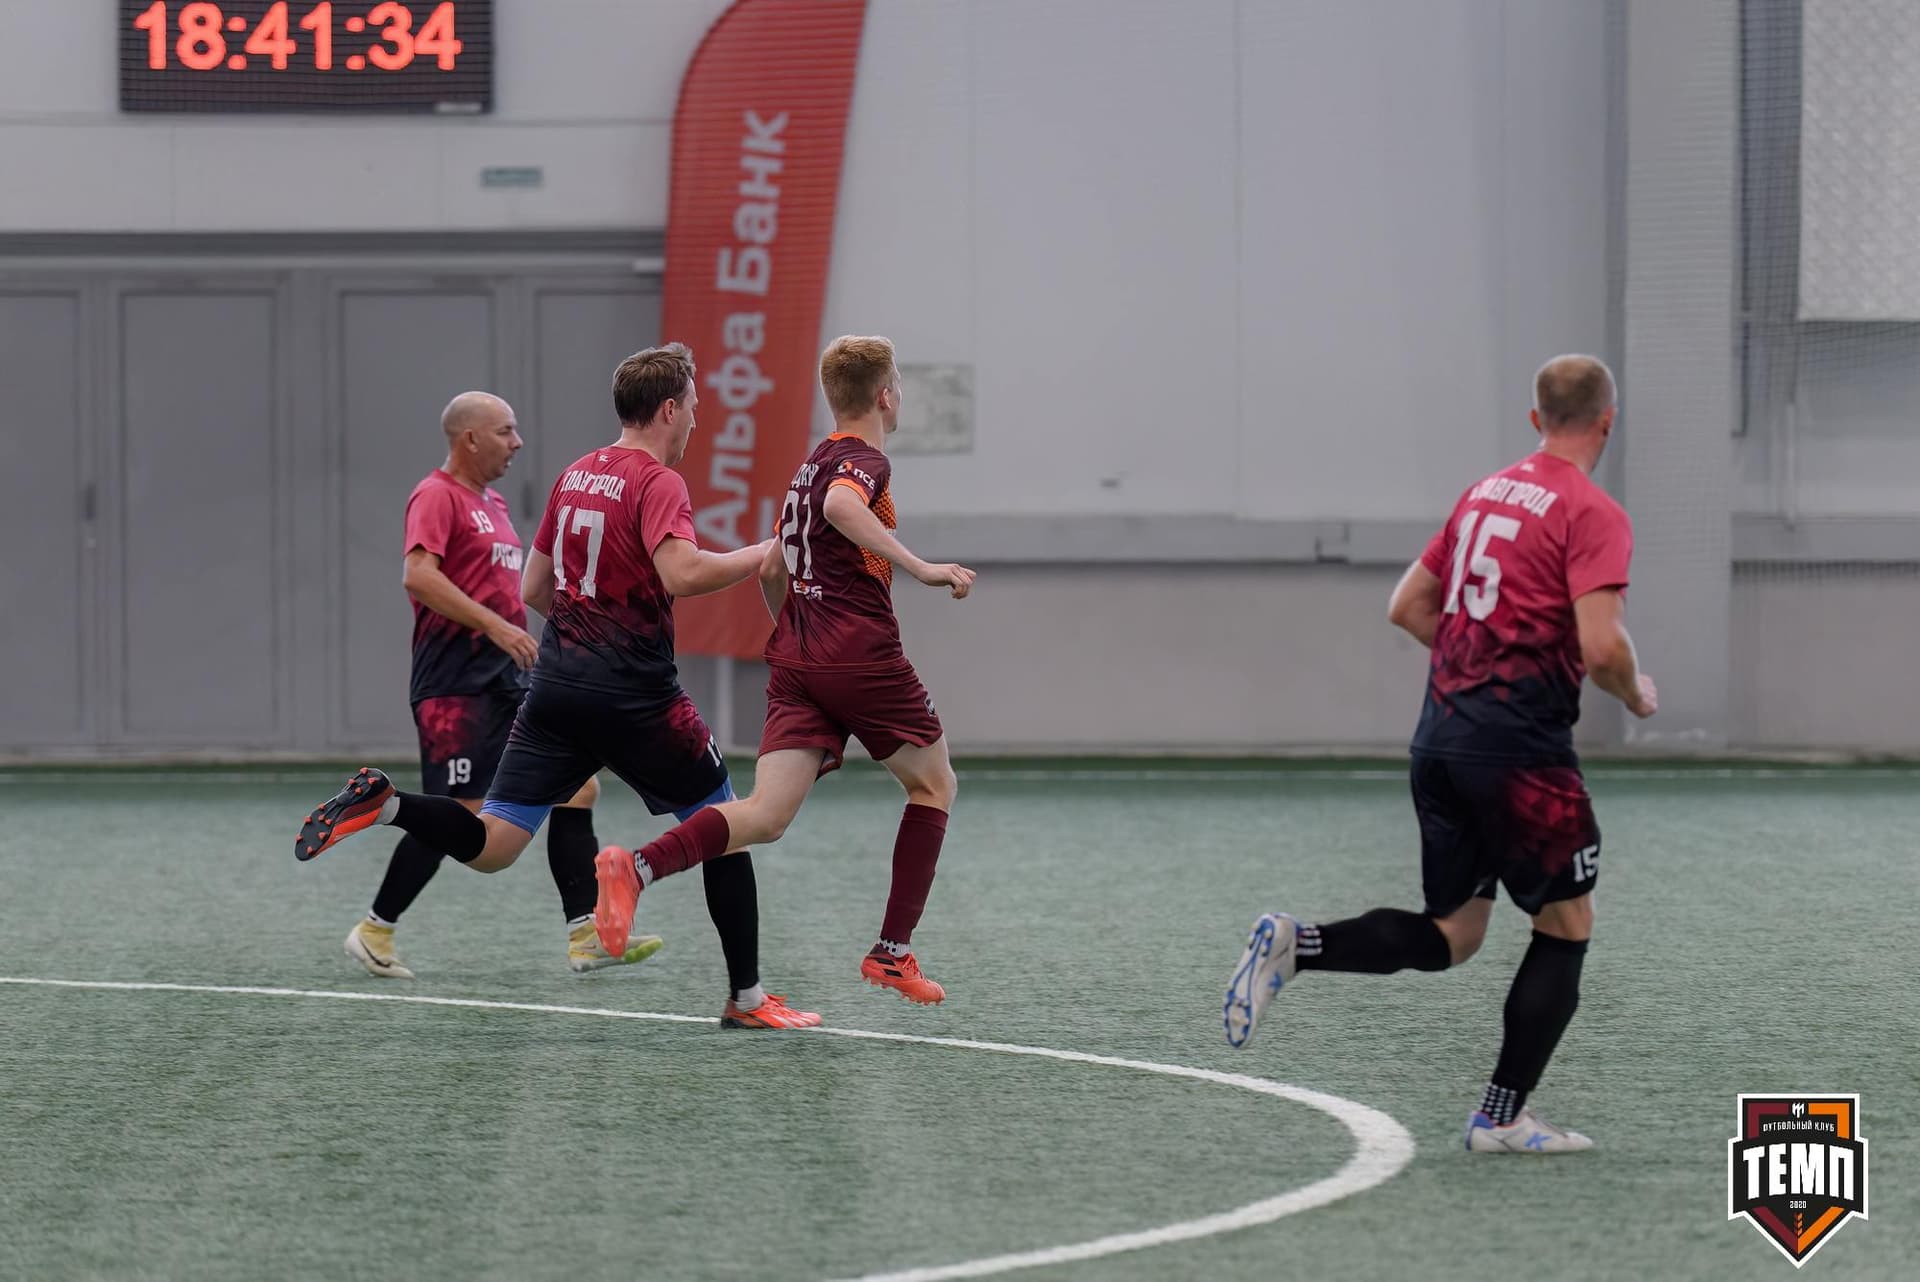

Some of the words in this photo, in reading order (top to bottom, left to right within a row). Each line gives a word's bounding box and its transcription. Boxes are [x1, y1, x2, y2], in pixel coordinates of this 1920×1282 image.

[133, 0, 464, 72] 18:41:34
[715, 108, 790, 295] Банк
[695, 311, 774, 551] Альфа
[470, 509, 496, 534] 19
[553, 505, 605, 600] 17
[780, 489, 814, 580] 21
[1443, 509, 1523, 622] 15
[447, 757, 472, 786] 19
[1572, 844, 1600, 883] 15
